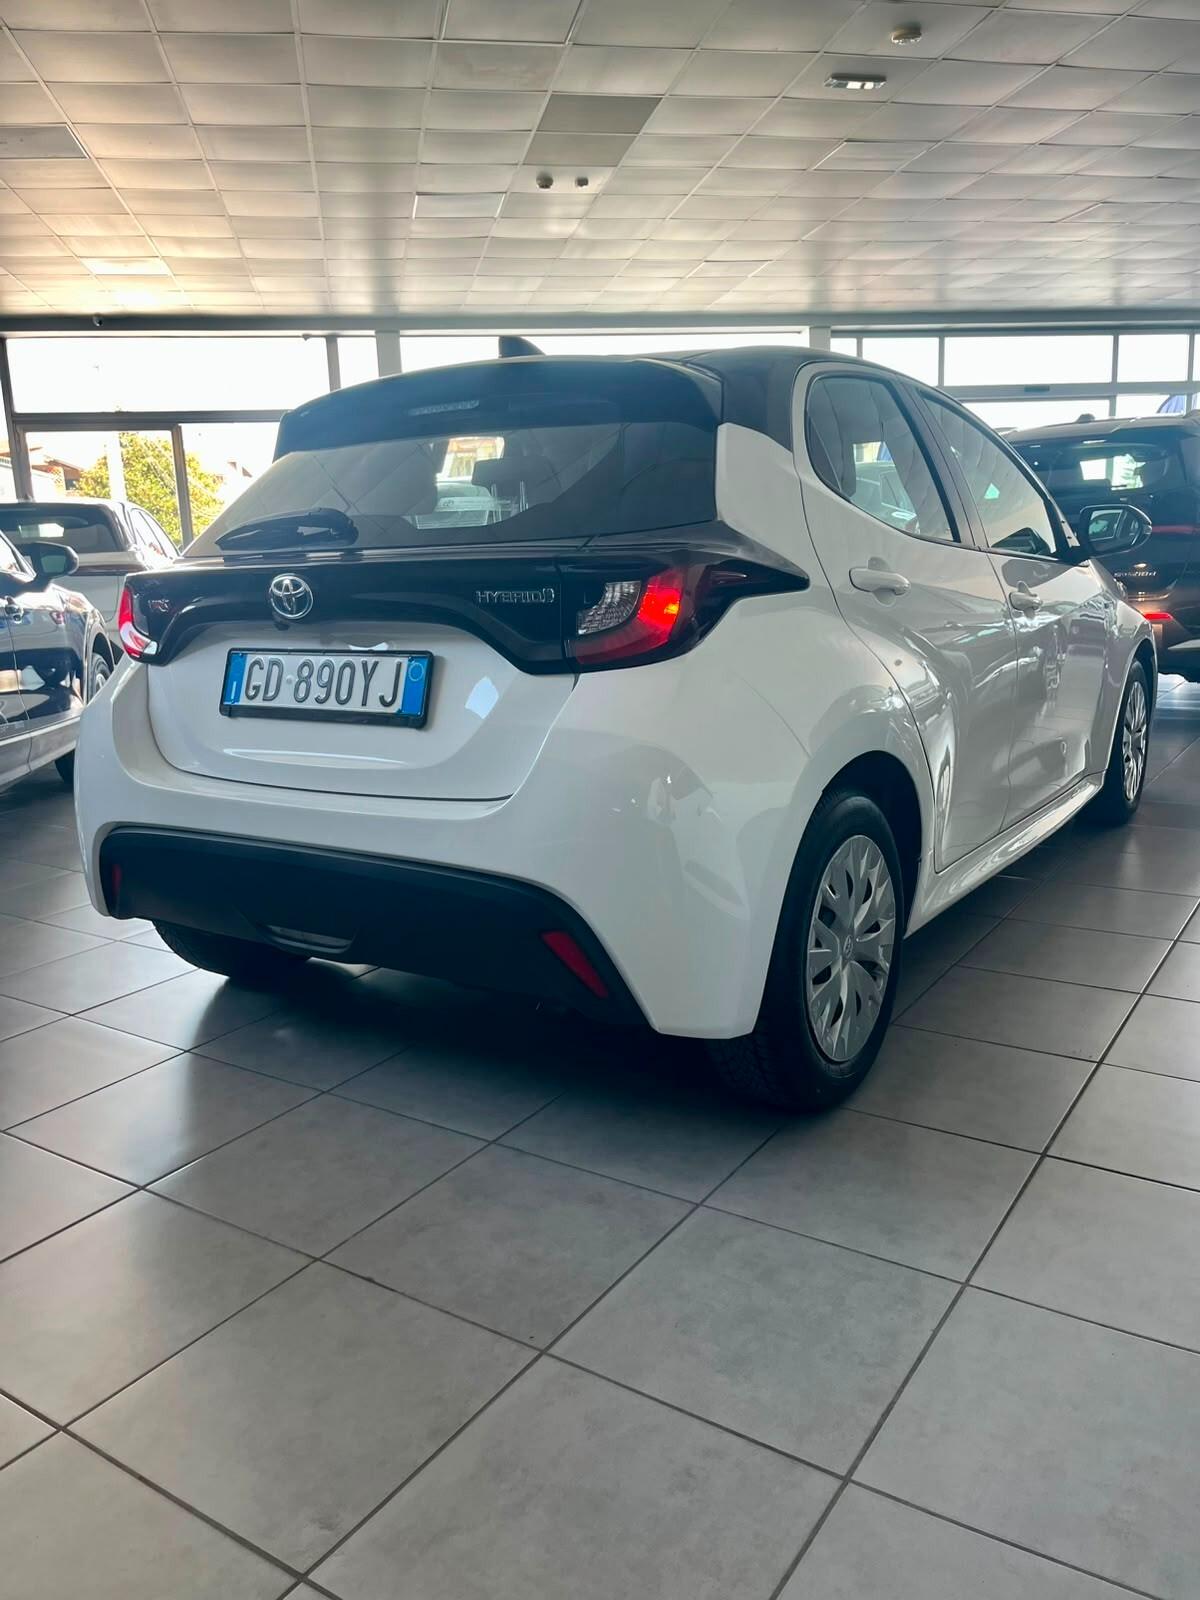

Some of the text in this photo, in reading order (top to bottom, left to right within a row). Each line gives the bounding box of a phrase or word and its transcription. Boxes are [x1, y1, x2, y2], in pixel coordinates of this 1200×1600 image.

[475, 591, 545, 603] HYBRID
[244, 657, 402, 708] GD 890YJ
